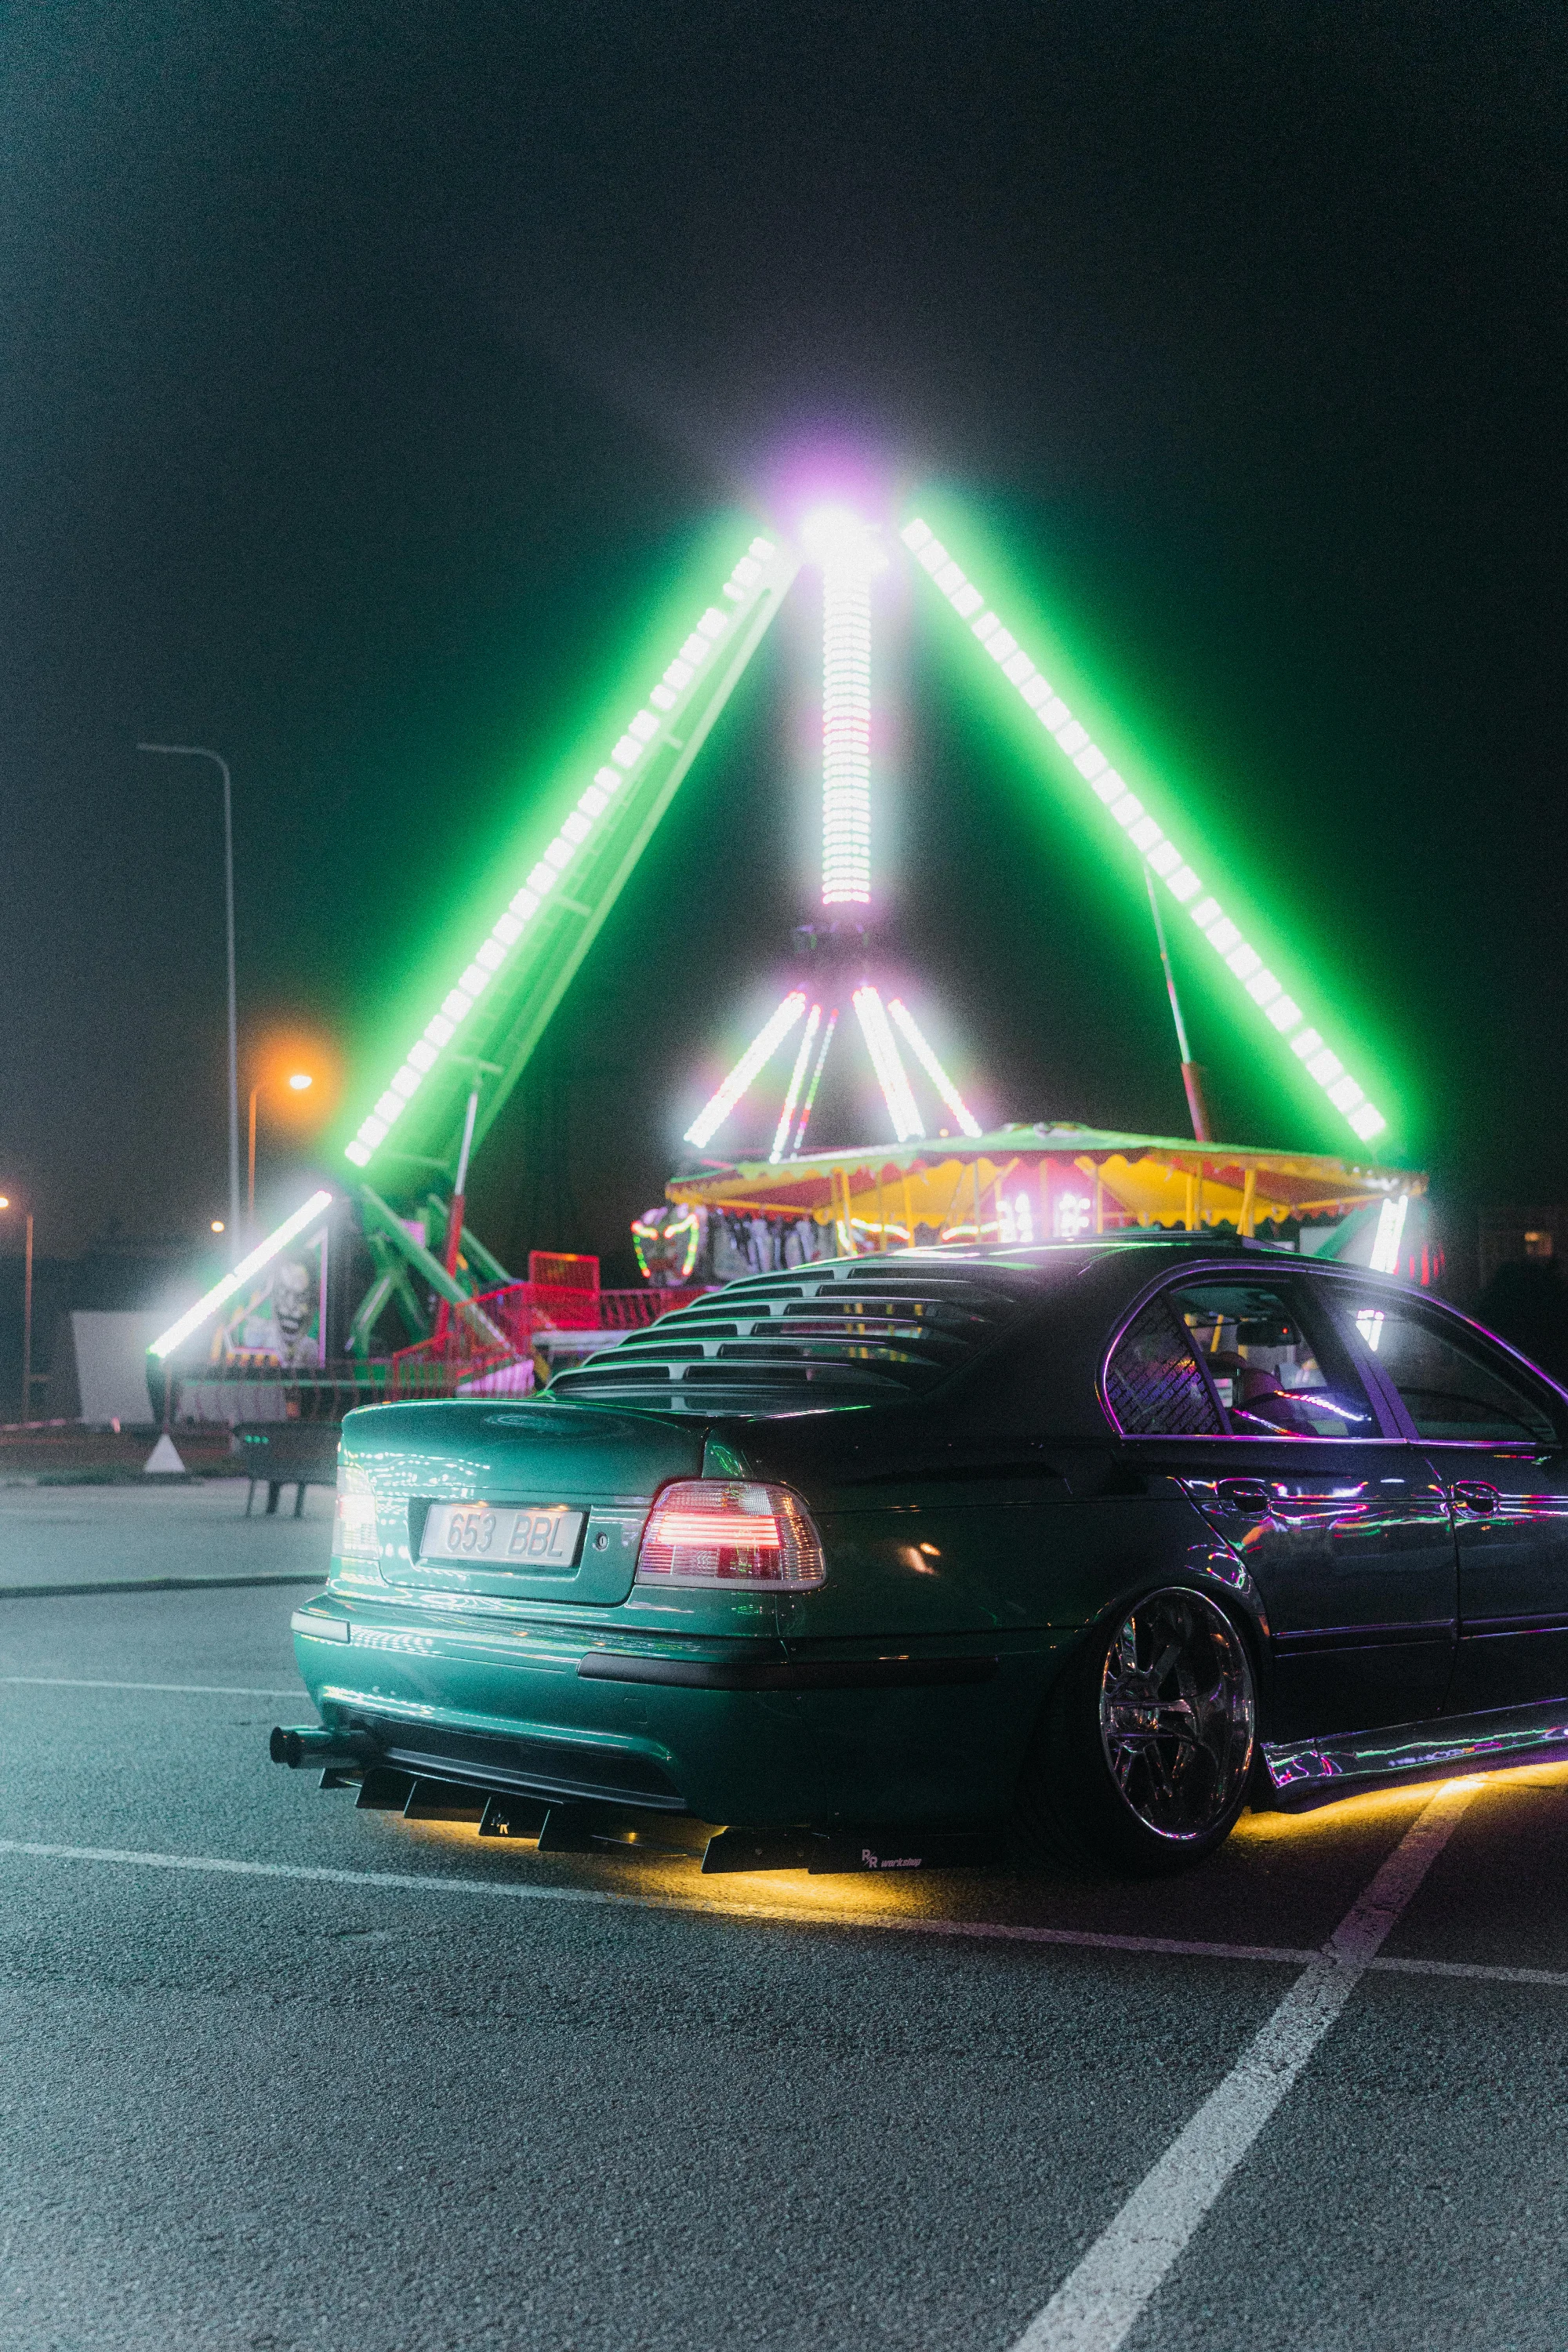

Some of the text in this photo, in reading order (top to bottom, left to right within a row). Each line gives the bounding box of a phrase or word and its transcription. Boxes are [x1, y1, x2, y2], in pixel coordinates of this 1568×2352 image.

[446, 1512, 563, 1558] 653 BBL
[880, 1857, 922, 1867] workshop
